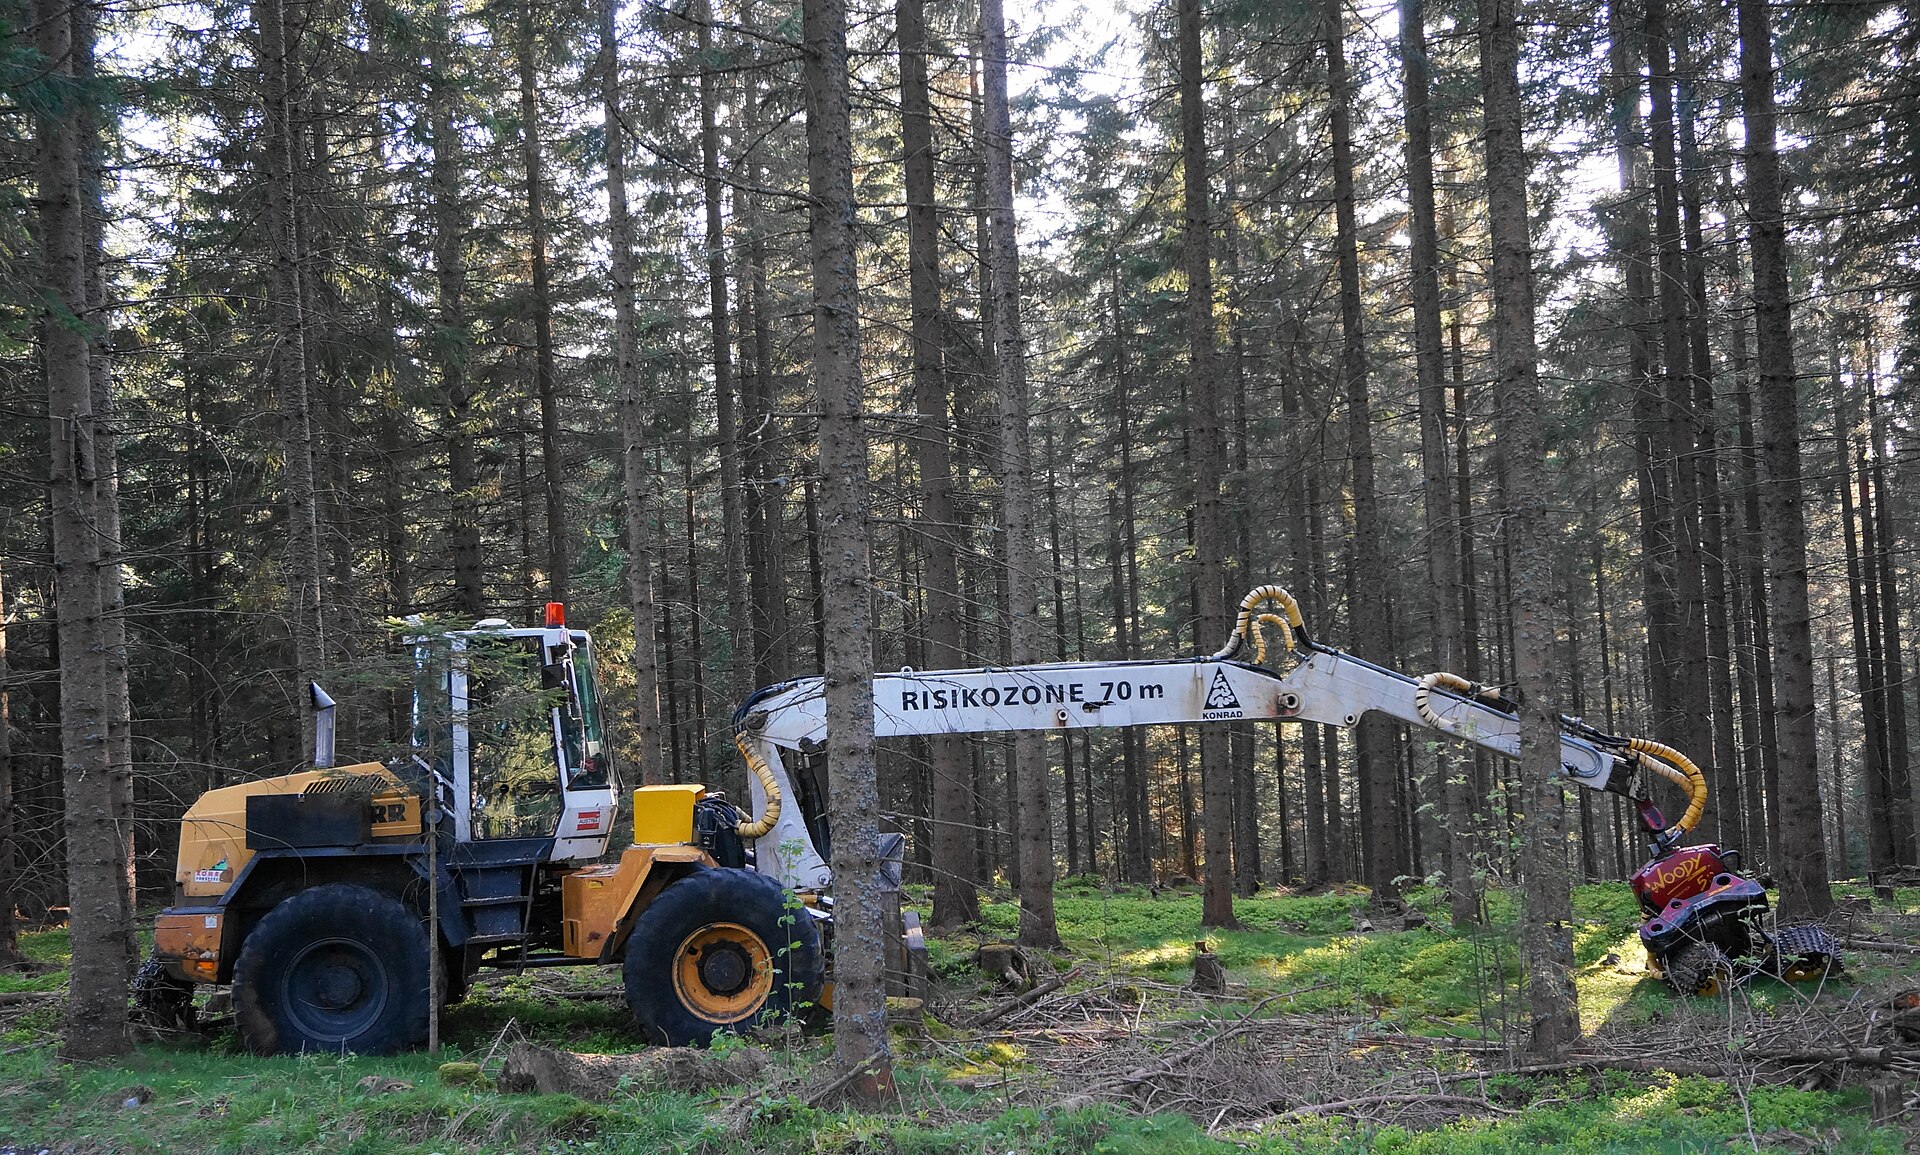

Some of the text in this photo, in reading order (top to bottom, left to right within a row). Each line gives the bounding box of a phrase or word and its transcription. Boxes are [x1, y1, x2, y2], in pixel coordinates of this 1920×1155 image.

[902, 681, 1164, 711] RISIKOZONE 70 m
[1203, 711, 1243, 719] KONRAD
[1645, 853, 1702, 893] WOODY
